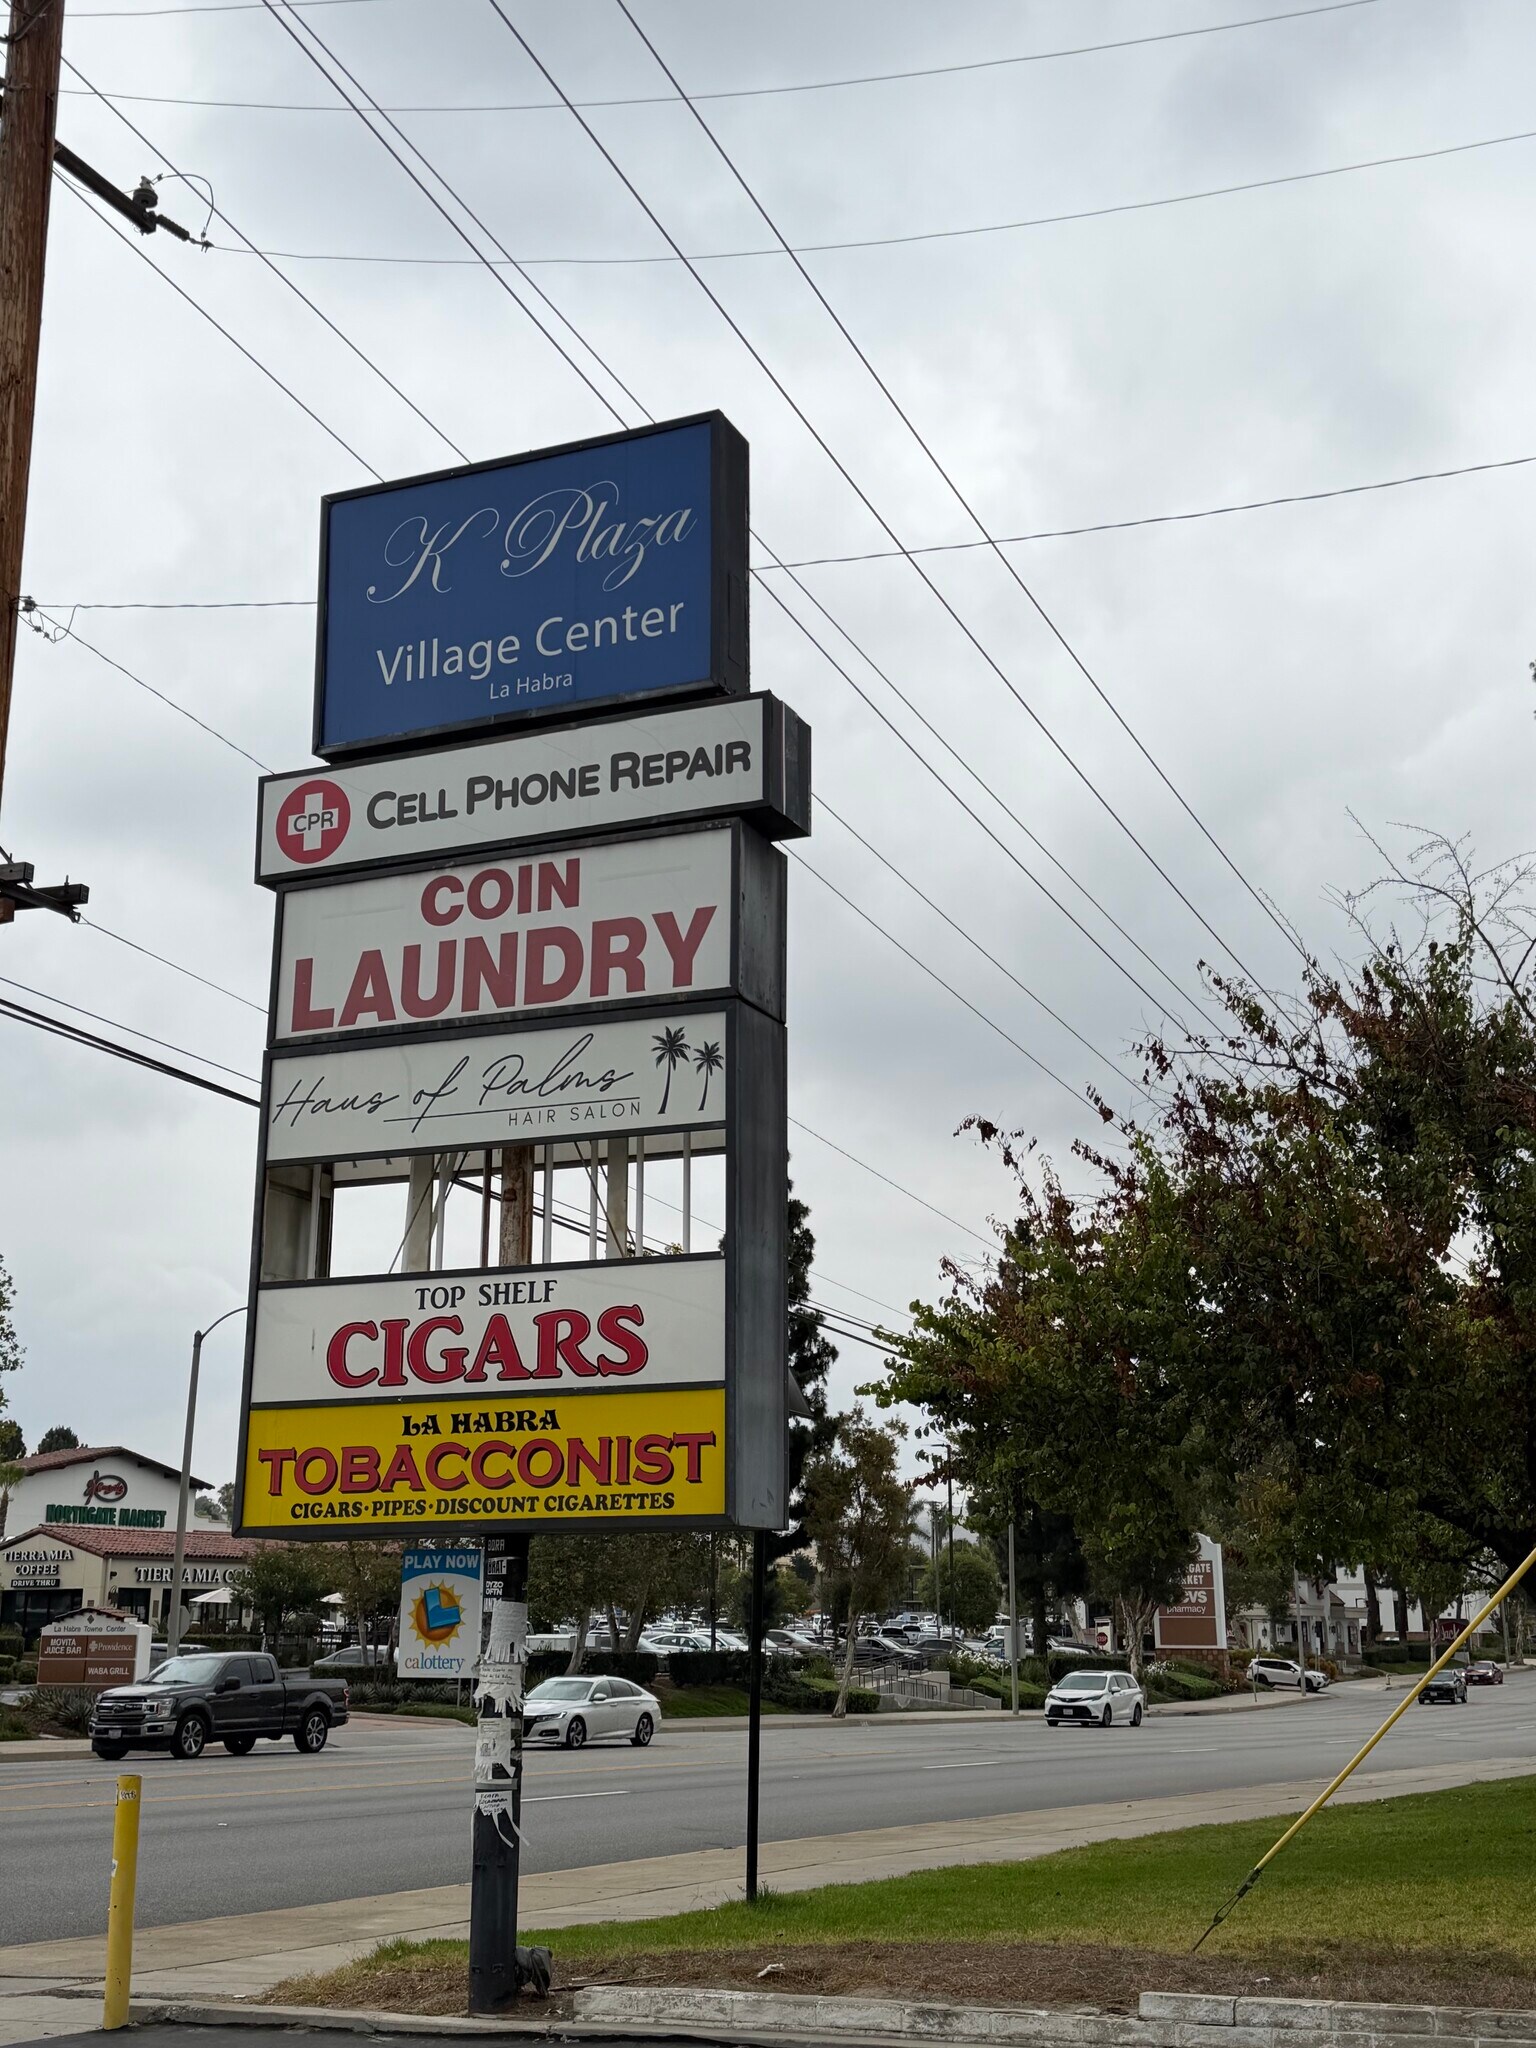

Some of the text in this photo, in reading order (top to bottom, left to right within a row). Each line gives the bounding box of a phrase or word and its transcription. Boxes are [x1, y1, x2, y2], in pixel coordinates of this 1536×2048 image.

[366, 481, 698, 603] K Plaza
[377, 602, 684, 686] Village Center
[489, 673, 573, 699] La Habra
[366, 741, 751, 830] CELL PHONE REPAIR
[293, 811, 334, 833] CPR
[421, 858, 580, 926] COIN
[291, 905, 717, 1032] LAUNDRY
[272, 1032, 634, 1133] Haus of Palms
[508, 1101, 642, 1127] HAIR SALON
[415, 1280, 558, 1310] TOP SHELF
[326, 1304, 649, 1388] CIGARS
[402, 1409, 561, 1436] LA HABRA
[258, 1431, 716, 1497] TOBACCONIST
[544, 1492, 675, 1512] CIGARETTES
[46, 1504, 167, 1528] NORTHGATE MARKET
[3, 1550, 74, 1561] TIERRA MIA
[404, 1555, 479, 1569] PLAY NOW
[14, 1564, 59, 1575] COFFEE
[135, 1567, 191, 1582] TIERA
[194, 1568, 221, 1583] MIA
[36, 1579, 56, 1587] THRU
[1166, 1605, 1206, 1615] pharmacy
[44, 1646, 82, 1654] JUICE BAR
[50, 1638, 77, 1646] MOVITA
[98, 1642, 133, 1651] Providence
[87, 1667, 130, 1675] WABA GRILL
[404, 1652, 465, 1674] calottery
